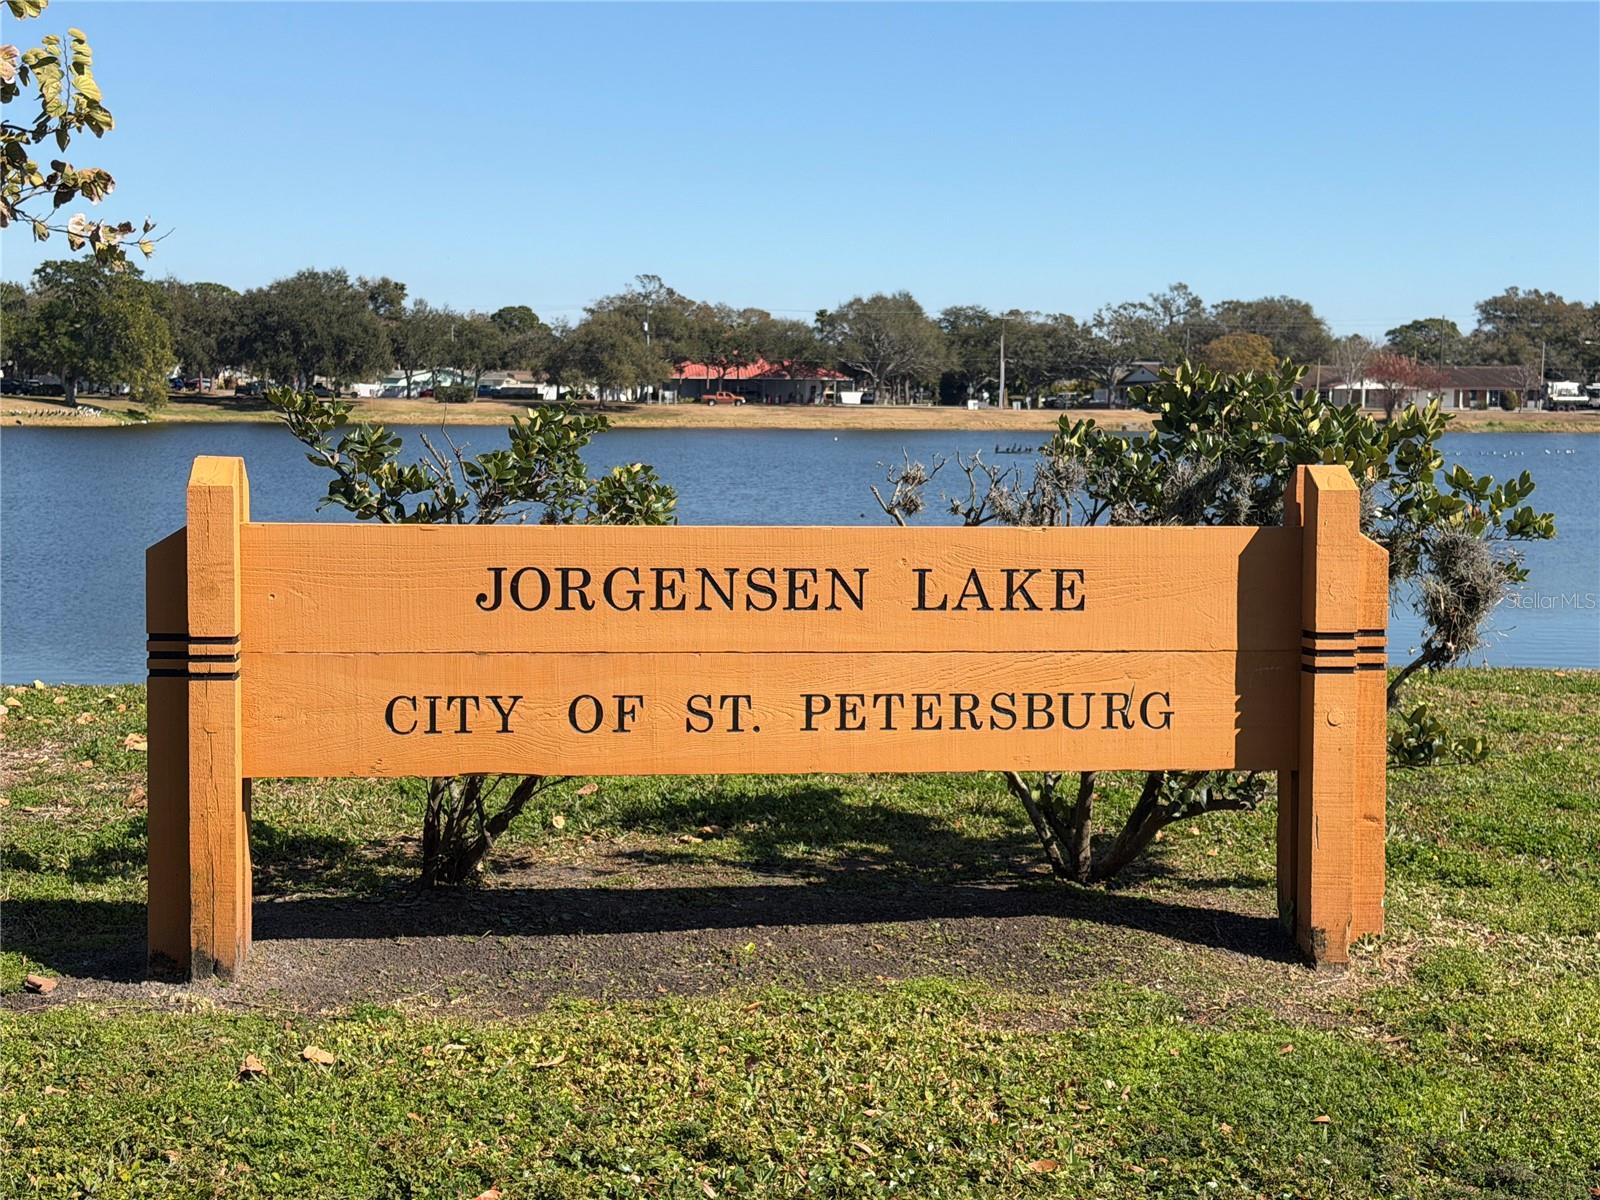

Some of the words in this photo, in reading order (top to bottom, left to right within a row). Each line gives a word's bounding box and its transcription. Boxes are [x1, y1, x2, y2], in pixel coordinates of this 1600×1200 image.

[476, 567, 869, 611] JORGENSEN
[912, 569, 1085, 611] LAKE
[385, 695, 523, 734] CITY
[569, 695, 643, 733] OF
[687, 695, 760, 732] ST.
[800, 692, 1174, 731] PETERSBURG
